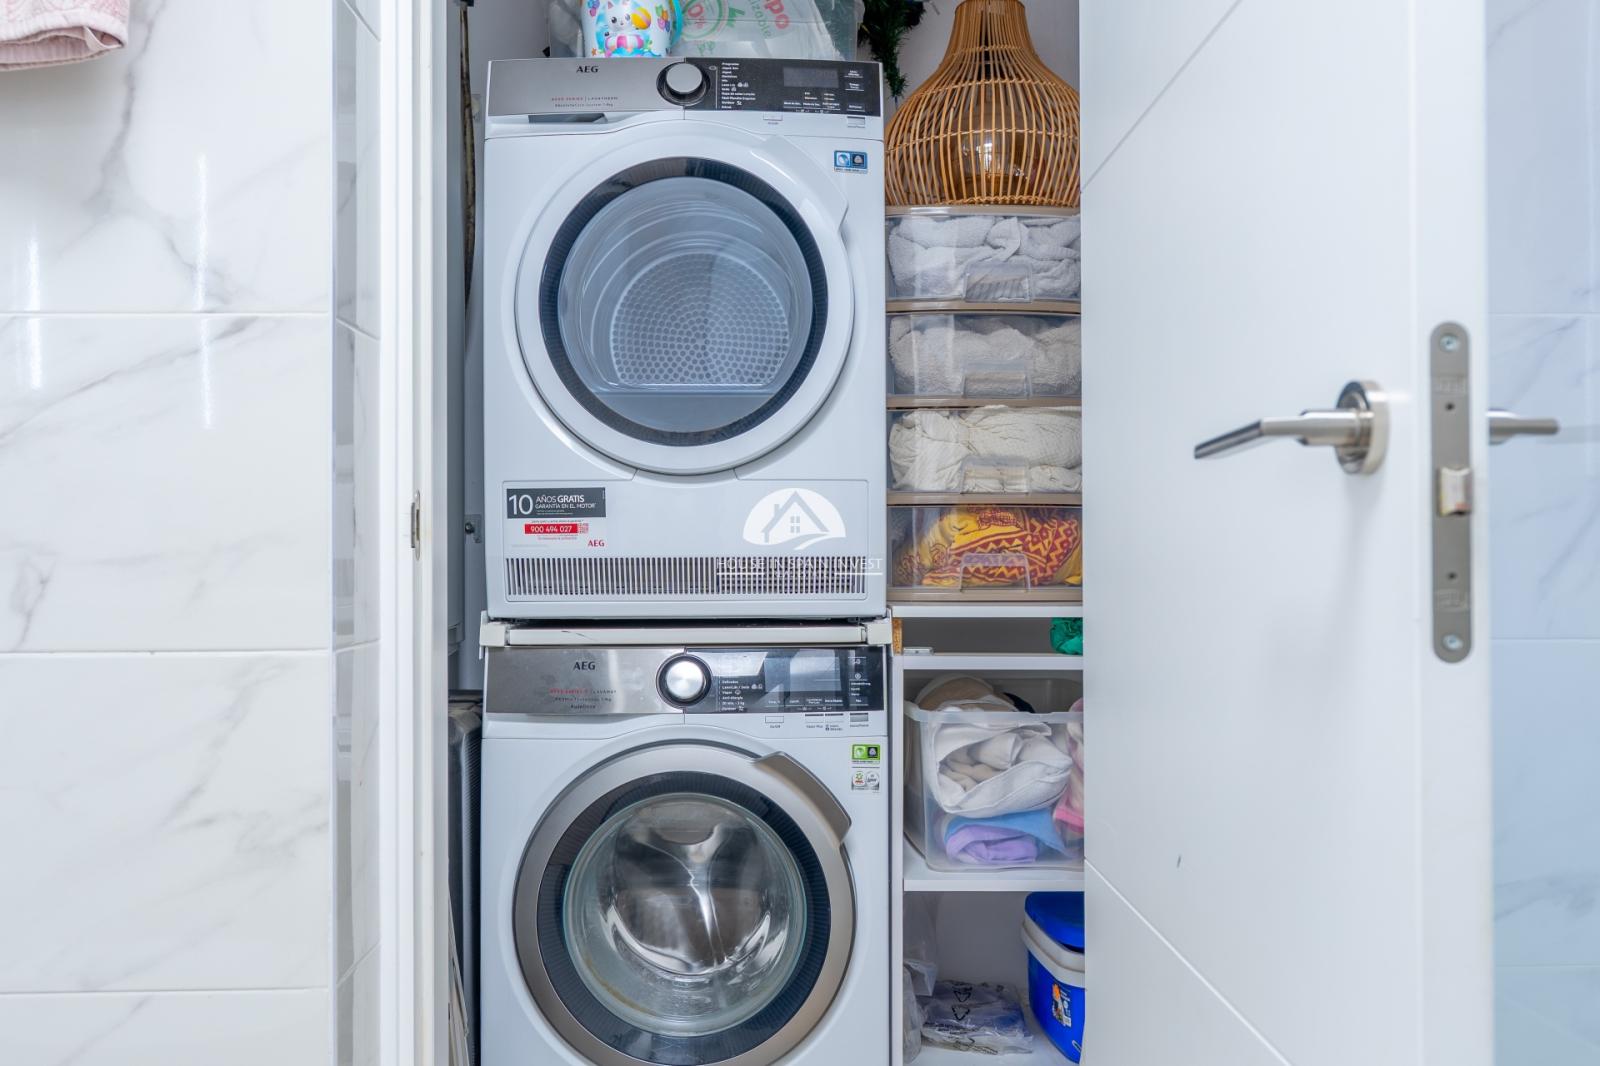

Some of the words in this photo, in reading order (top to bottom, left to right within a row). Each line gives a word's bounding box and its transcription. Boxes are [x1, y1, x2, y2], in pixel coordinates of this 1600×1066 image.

[576, 65, 599, 73] AEG
[535, 494, 557, 503] AÑOS
[557, 494, 585, 503] GRATIS
[508, 494, 534, 515] 10
[530, 525, 544, 533] 900
[560, 525, 572, 533] 027
[588, 539, 605, 547] AEG
[573, 661, 596, 671] AEG
